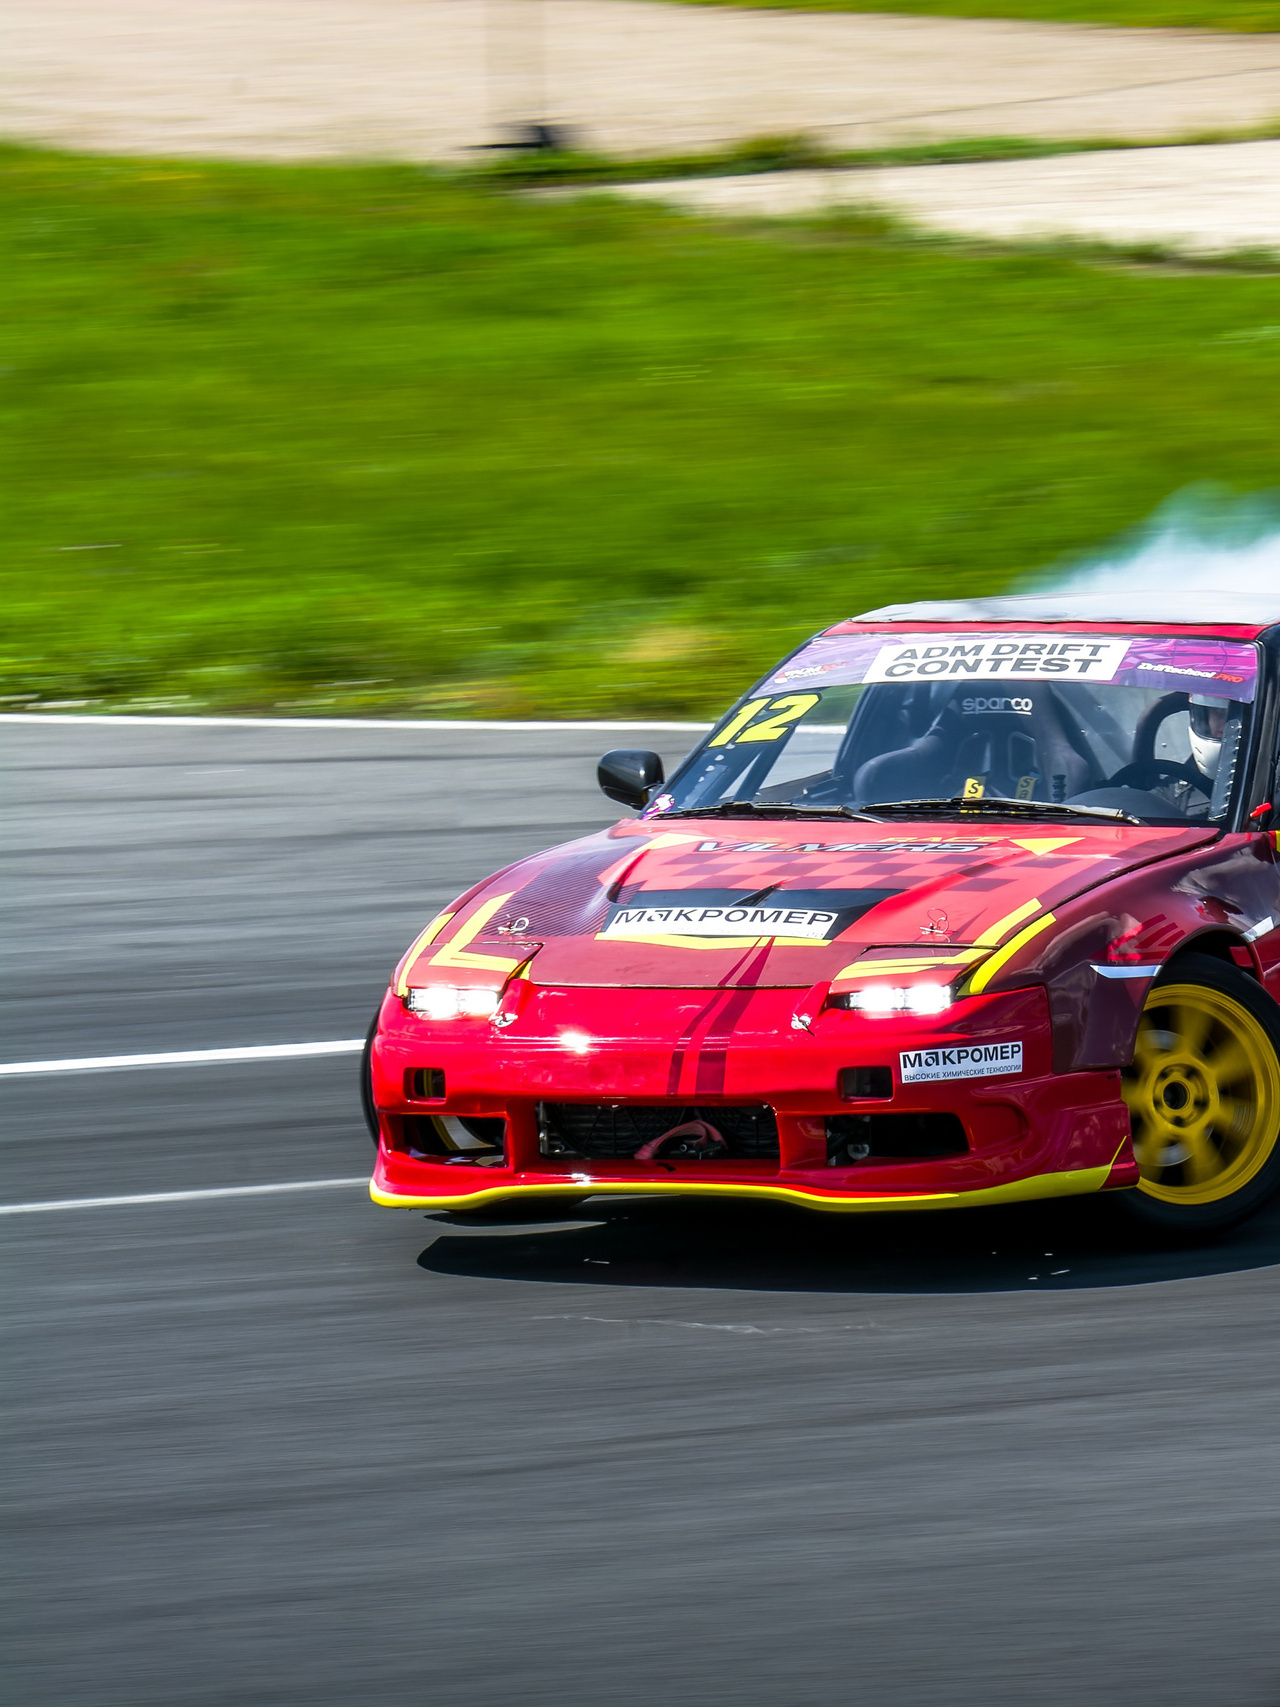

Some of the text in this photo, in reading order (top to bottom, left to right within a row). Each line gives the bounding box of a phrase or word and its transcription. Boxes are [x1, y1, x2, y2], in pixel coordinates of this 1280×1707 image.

[893, 643, 1111, 662] ADM DRIFT
[884, 658, 1102, 678] CONTEST
[962, 697, 1033, 715] sparco
[707, 694, 820, 747] 12
[694, 841, 991, 853] VILMERS
[904, 1064, 1021, 1081] ВЫСОКИЕ ХИМИЧЕСКИЕ ТЕХНОЛОГИИ
